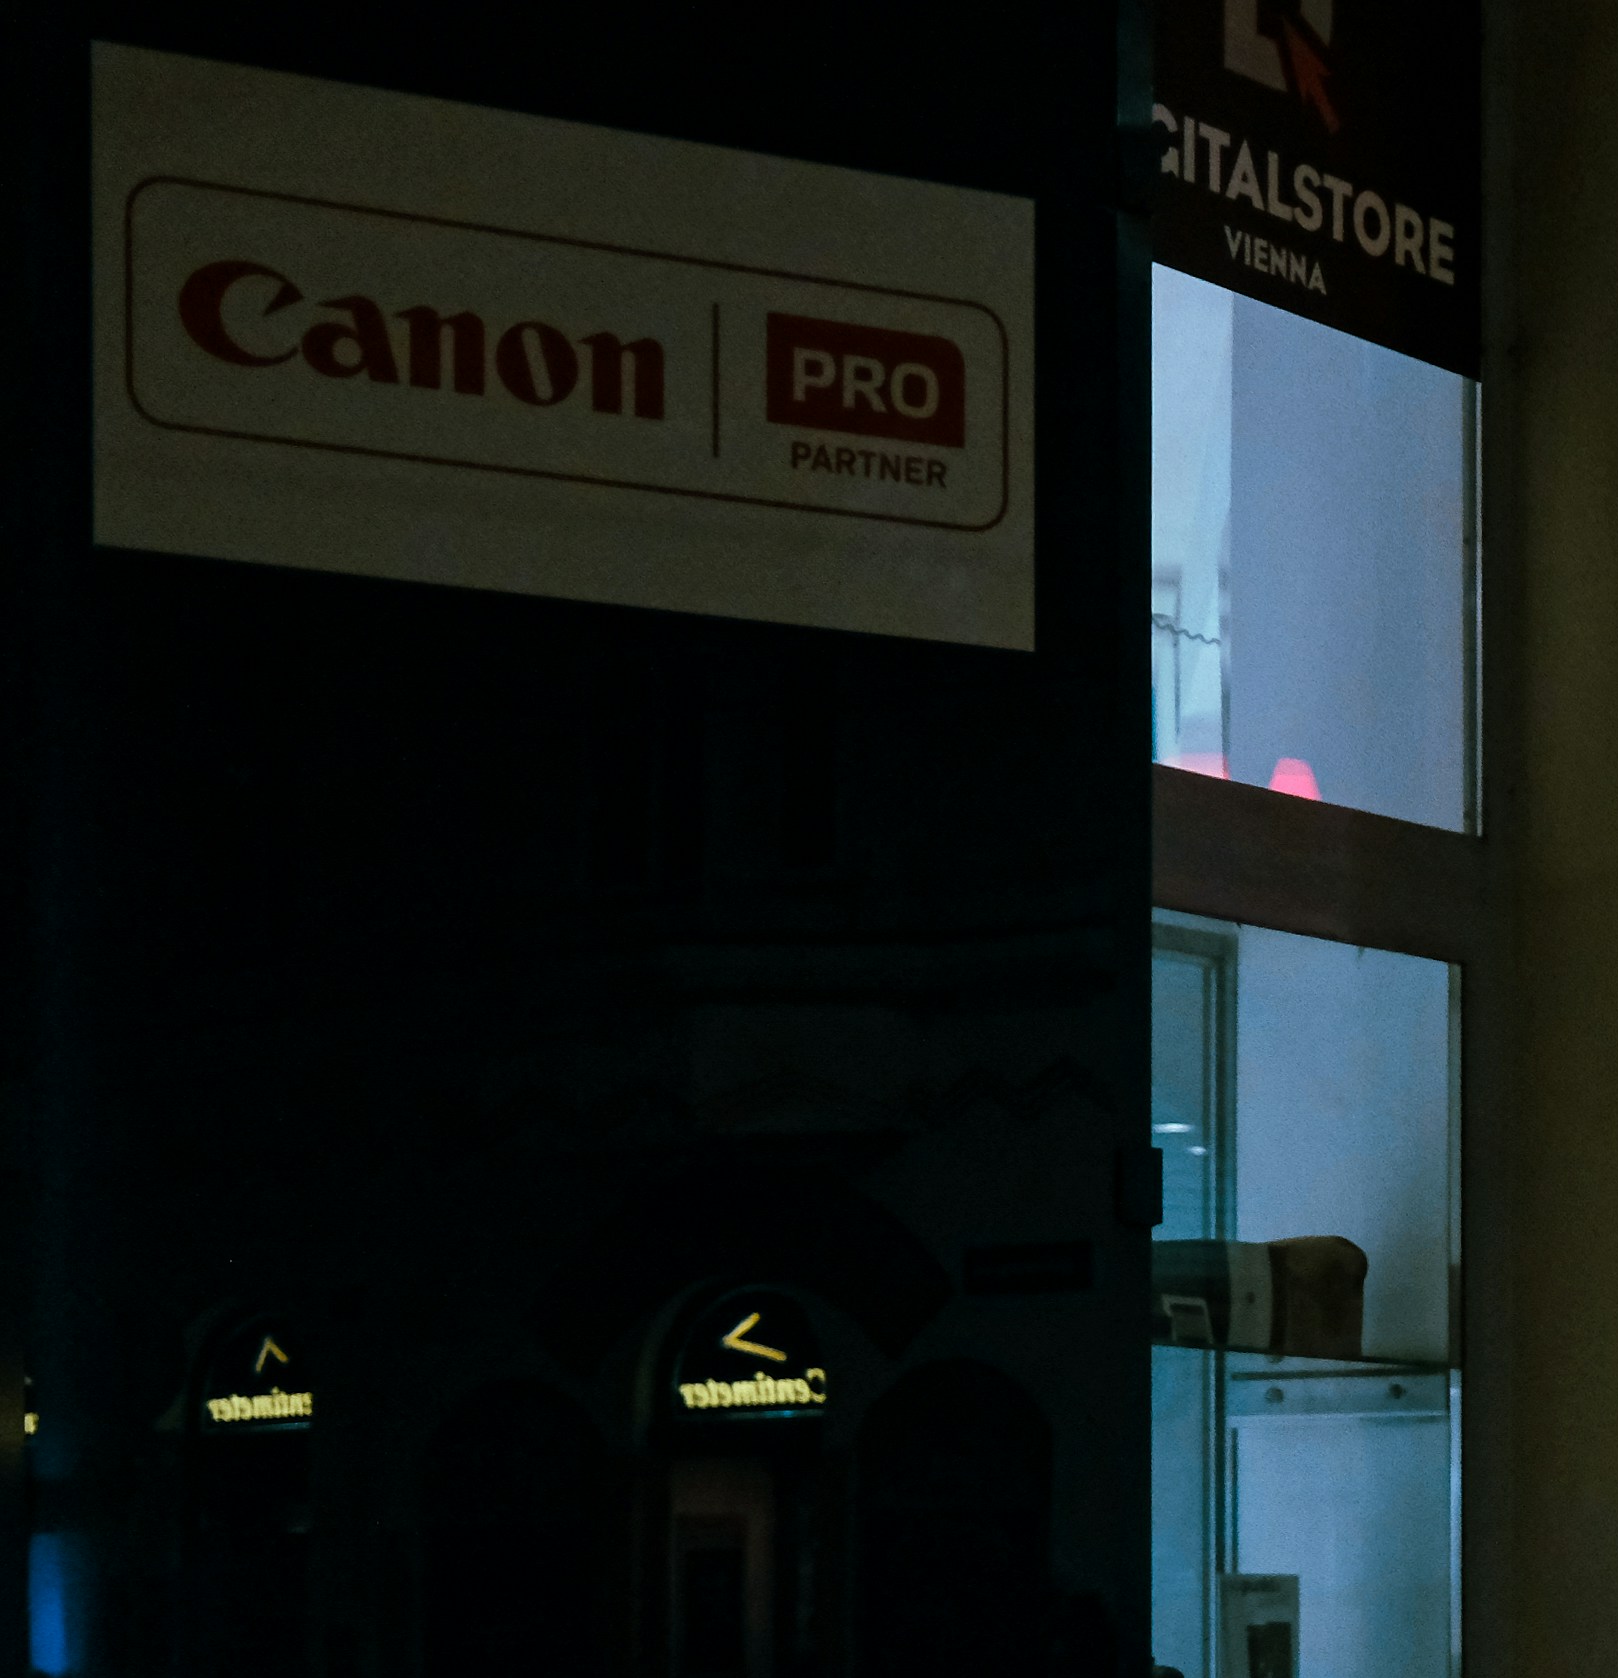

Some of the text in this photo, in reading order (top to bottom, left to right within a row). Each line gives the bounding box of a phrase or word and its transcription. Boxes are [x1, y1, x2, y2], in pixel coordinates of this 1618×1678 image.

[1224, 225, 1327, 296] VIENNA
[179, 261, 664, 420] Canon
[791, 346, 941, 420] PRO
[790, 441, 947, 488] PARTNER
